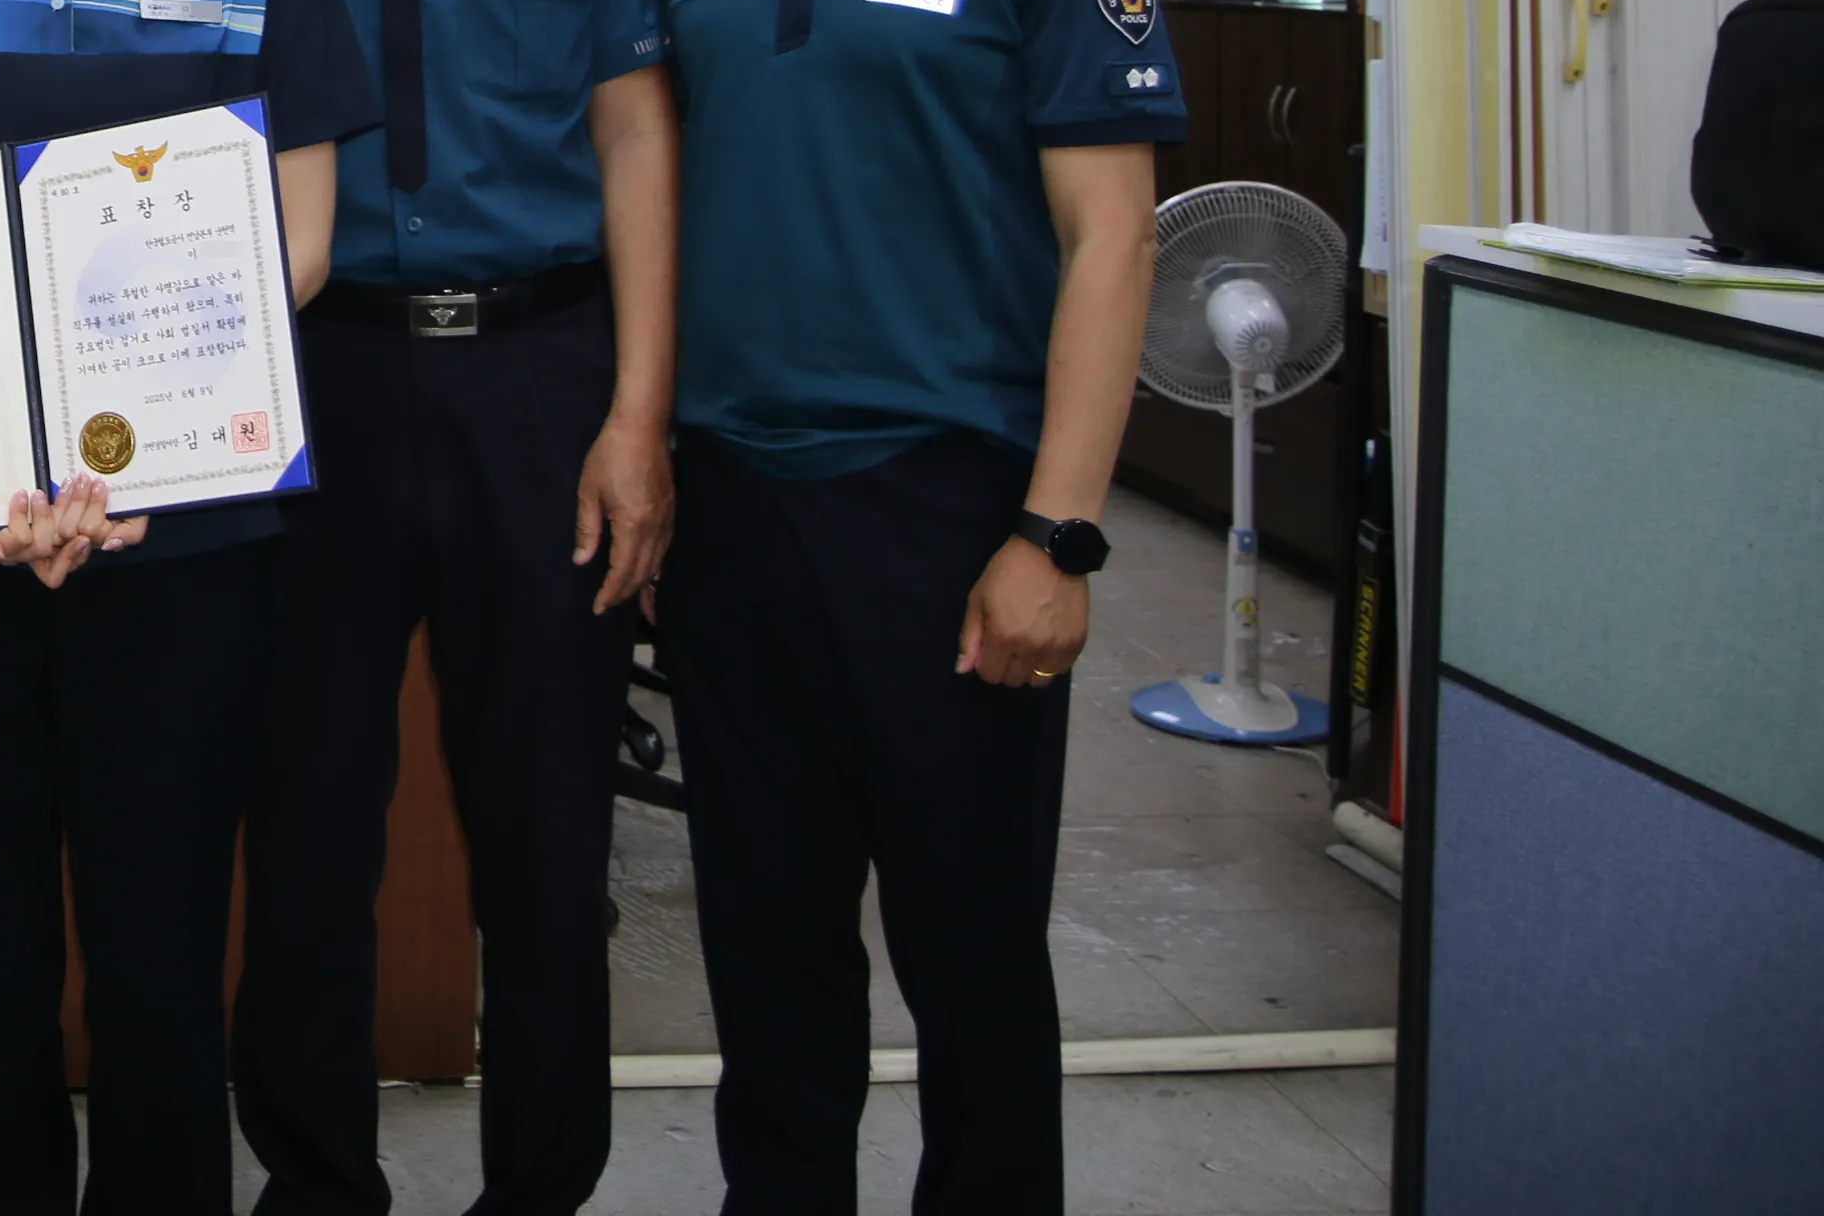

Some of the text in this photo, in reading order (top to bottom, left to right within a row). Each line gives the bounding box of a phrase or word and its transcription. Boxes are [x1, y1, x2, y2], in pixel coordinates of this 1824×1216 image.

[1119, 13, 1149, 24] POLICE
[99, 188, 194, 226] 표창장
[87, 291, 116, 306] 귀하는
[154, 276, 202, 295] 사명감으로
[231, 269, 243, 281] 바
[107, 310, 136, 325] 성실히
[140, 304, 180, 320] 수행하여
[74, 336, 115, 354] 중요범인
[119, 332, 151, 347] 검거로
[155, 327, 175, 340] 사회
[76, 338, 250, 376] 기여한 공이 크므로 이에 표창합니다.
[143, 390, 173, 404] 2025년
[1352, 585, 1374, 692] SCANNER
